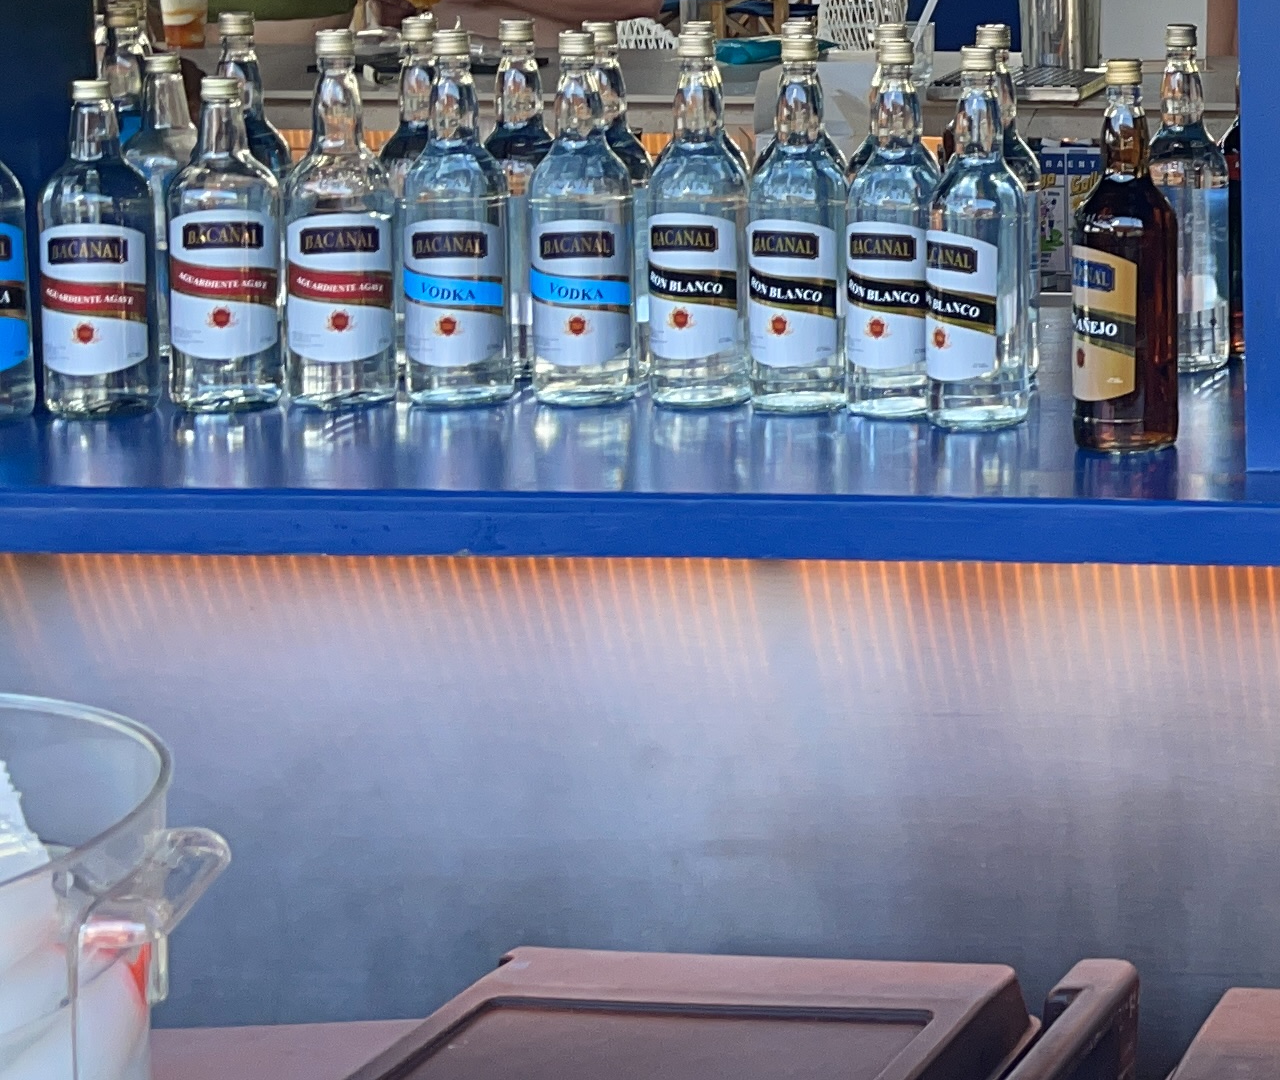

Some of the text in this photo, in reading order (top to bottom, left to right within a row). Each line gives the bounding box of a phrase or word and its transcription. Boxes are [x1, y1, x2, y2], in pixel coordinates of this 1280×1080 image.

[187, 224, 257, 246] BACANAL
[304, 228, 375, 250] BACANAL
[415, 234, 482, 256] BACANAL
[652, 227, 715, 248] BACANAL
[753, 234, 815, 256] BACANAL
[51, 238, 124, 261] BACANAL
[543, 235, 611, 257] BACANAL
[852, 237, 912, 258] BACANAL
[178, 271, 238, 289] AGUARDIENTE
[296, 276, 356, 293] AGUARDIENTE
[421, 281, 476, 300] VODKA
[549, 281, 604, 300] VODKA
[650, 271, 723, 296] RON BLANCO
[750, 277, 823, 303] RON BLANCO
[45, 287, 134, 306] AGUARDIENTE AGAVE
[848, 280, 920, 305] RON BLANCO
[932, 299, 981, 318] BLANCO
[1074, 318, 1118, 337] AÑEJO
